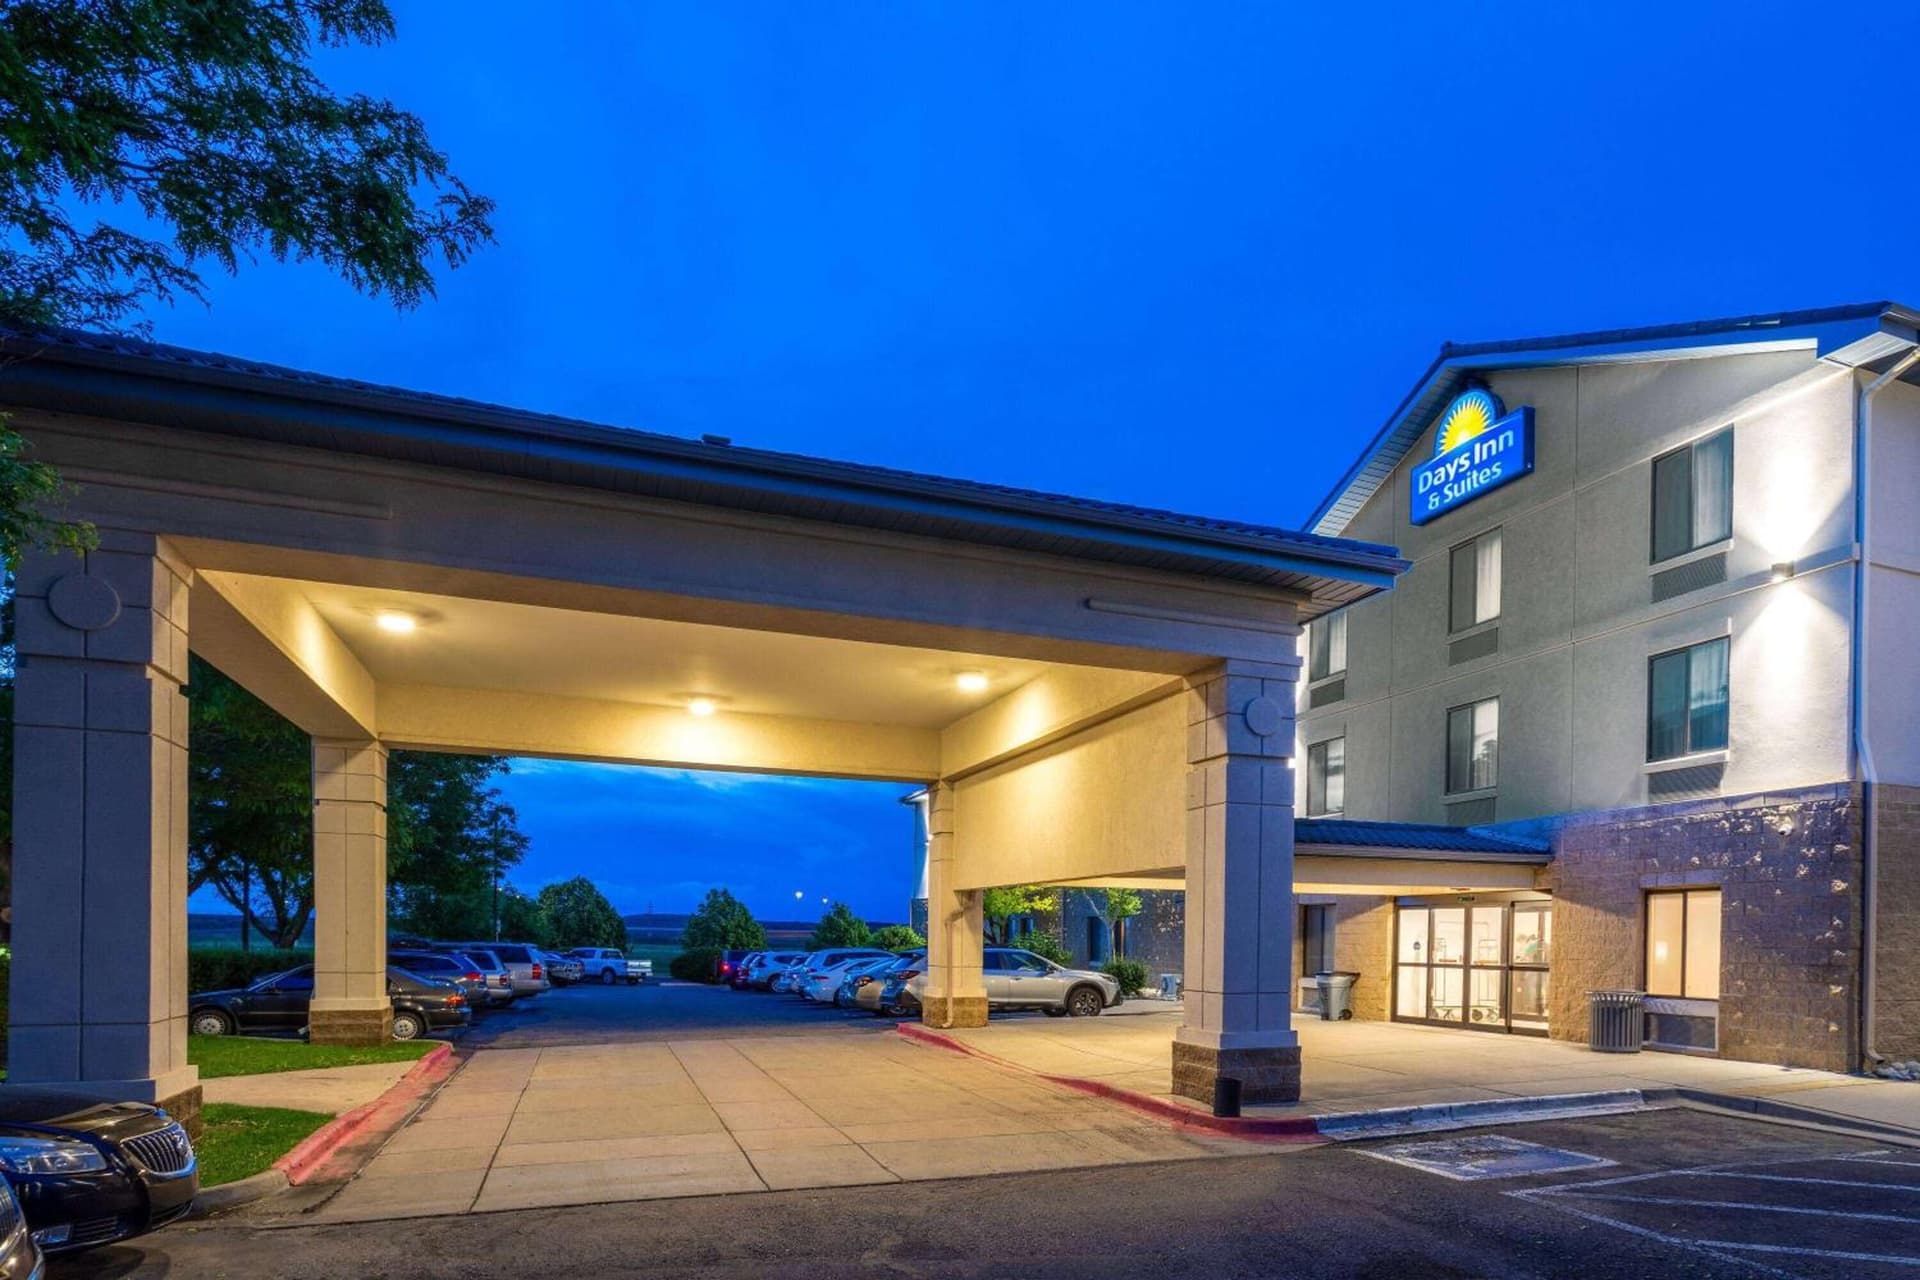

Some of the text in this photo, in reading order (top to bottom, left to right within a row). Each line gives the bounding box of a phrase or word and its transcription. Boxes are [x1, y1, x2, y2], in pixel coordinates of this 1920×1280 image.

[1418, 430, 1513, 495] Days Inn
[1428, 462, 1501, 510] & Suites
